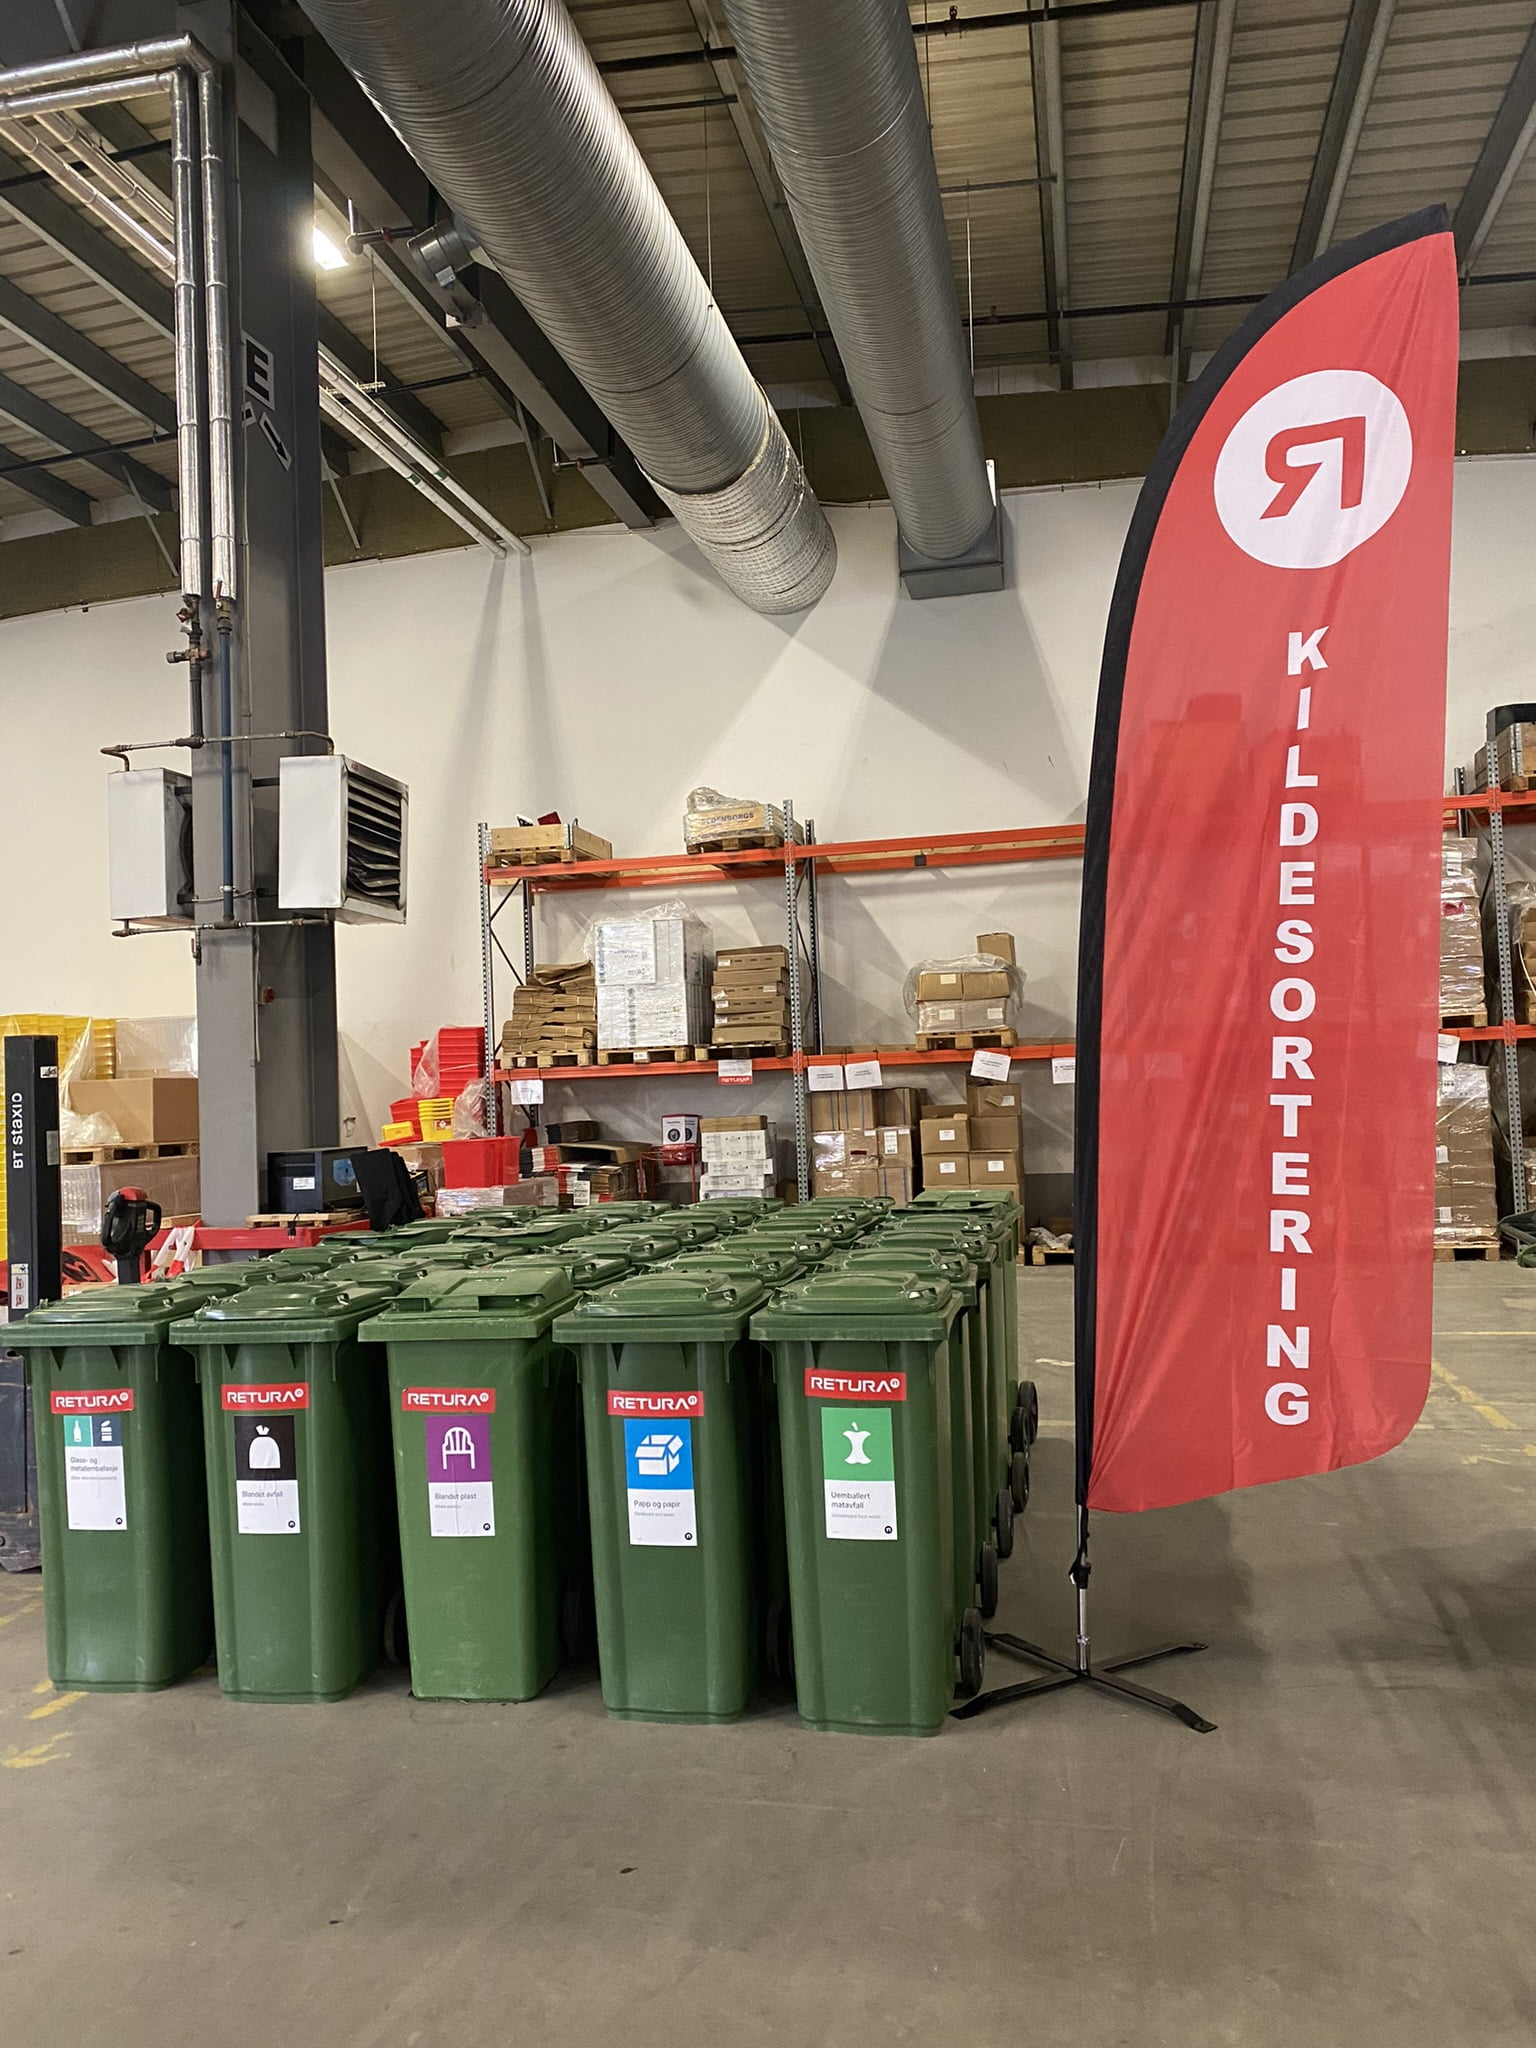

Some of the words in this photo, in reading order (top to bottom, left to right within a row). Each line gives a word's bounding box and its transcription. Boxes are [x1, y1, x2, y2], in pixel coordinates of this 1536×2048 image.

[1264, 625, 1329, 1426] KILDESORTERING
[12, 1150, 24, 1169] BT
[811, 1377, 892, 1393] RETURA
[55, 1395, 122, 1408] RETURA
[227, 1390, 297, 1404] RETURA
[407, 1393, 482, 1406] RETURA
[613, 1396, 690, 1410] RETURA
[89, 1457, 98, 1465] og
[242, 1490, 265, 1498] Blandet
[266, 1490, 284, 1498] avfall
[460, 1493, 477, 1501] plast
[831, 1491, 871, 1500] Uemballert
[633, 1499, 652, 1509] Papp
[652, 1501, 662, 1509] og
[662, 1501, 681, 1509] papir
[831, 1501, 865, 1509] matavfall
